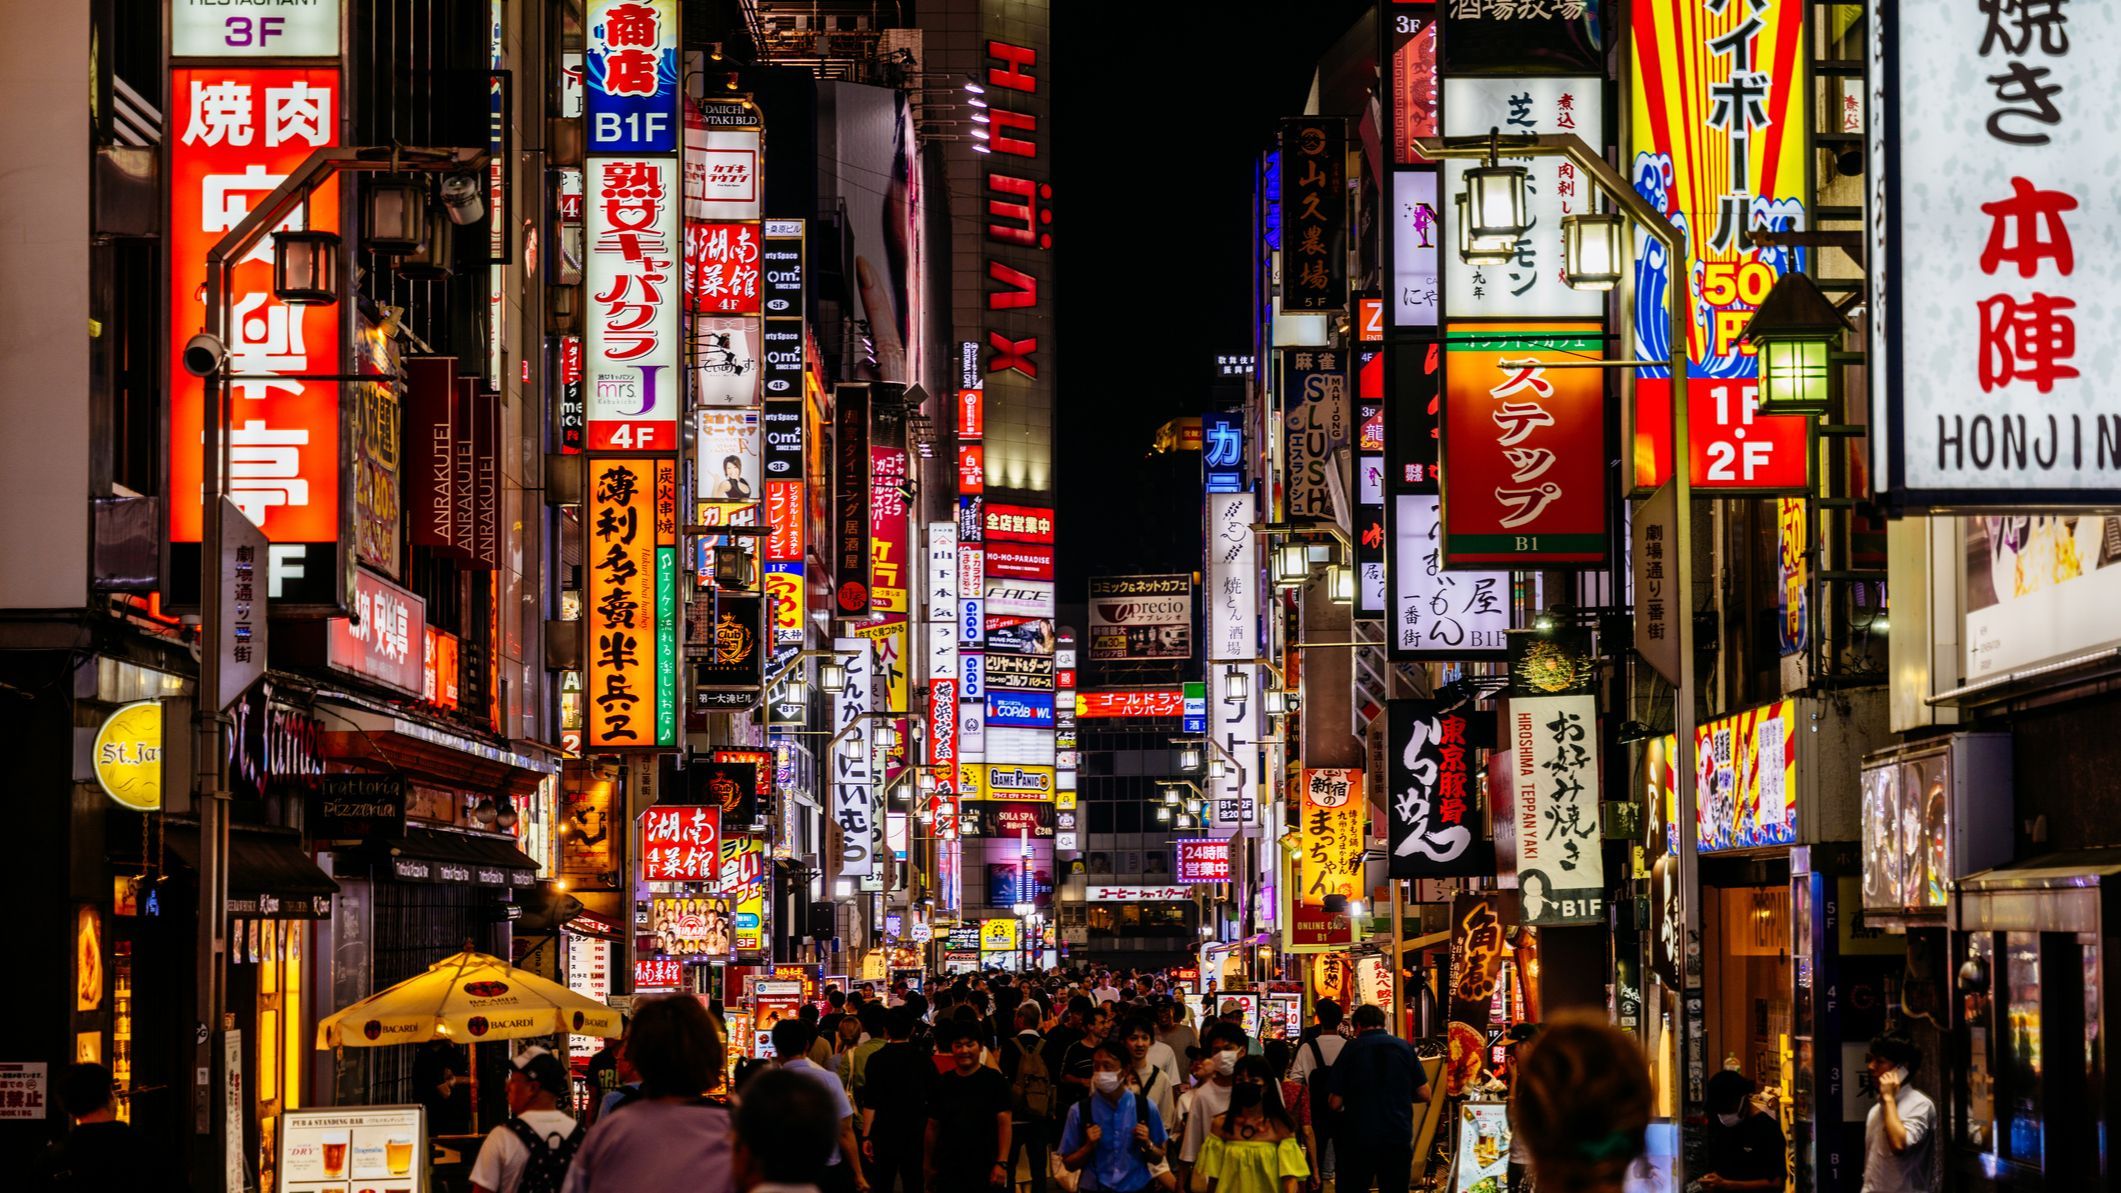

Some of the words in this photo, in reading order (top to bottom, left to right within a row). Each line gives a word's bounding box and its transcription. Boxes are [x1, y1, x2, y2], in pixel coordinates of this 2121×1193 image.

[224, 16, 286, 47] 3F
[1395, 15, 1421, 34] 3F
[605, 2, 662, 97] 商店
[181, 80, 332, 147] 焼肉
[594, 112, 669, 143] B1F
[735, 115, 758, 125] BLD
[593, 161, 674, 362] 熟女キャバクラ
[698, 226, 759, 264] 湖南
[1303, 296, 1328, 307] 5F
[1976, 175, 2081, 394] 本陣
[718, 298, 740, 310] 4F
[1294, 352, 1337, 371] 麻雀
[1361, 352, 1373, 362] 4F
[1361, 406, 1376, 417] 3F
[610, 423, 655, 449] 4F
[1489, 357, 1562, 529] ステップ
[1937, 414, 2121, 471] HONJIN
[1706, 440, 1774, 481] 2F
[432, 422, 449, 539] ANRAKUTEI
[456, 439, 472, 552] ANRAKUTEI
[478, 455, 495, 565] ANRAKUTEI
[656, 467, 674, 534] 炭火串焼
[770, 483, 785, 559] リフレッシュ
[986, 512, 1051, 536] 全店営業中
[986, 552, 1051, 565] MO-MO-PARADISE
[1515, 536, 1539, 551] B1
[771, 564, 788, 572] 1F
[1645, 524, 1665, 641] 劇場通り一番街
[234, 544, 255, 664] 劇場通り一番街
[986, 587, 1053, 602] FACE
[1462, 578, 1503, 615] 屋
[965, 601, 977, 639] GiGO
[1403, 594, 1422, 648] 一番街
[965, 657, 977, 695] GiGO
[1121, 704, 1175, 716] ハンバーグ
[1517, 712, 1532, 777] HIROSHIMA
[1439, 714, 1468, 824] 東京豚骨
[1541, 710, 1597, 872] お好み焼き
[647, 807, 716, 845] 湖南
[998, 812, 1019, 821] SOLA
[1019, 812, 1034, 821] SPA
[1185, 846, 1229, 860] 24時間
[1185, 862, 1229, 876] 営業中
[1309, 809, 1337, 895] まっちゃん
[1098, 888, 1136, 900] コーヒー
[1561, 899, 1601, 917] B1F
[737, 939, 756, 948] 3F
[1297, 921, 1325, 931] ONLINE
